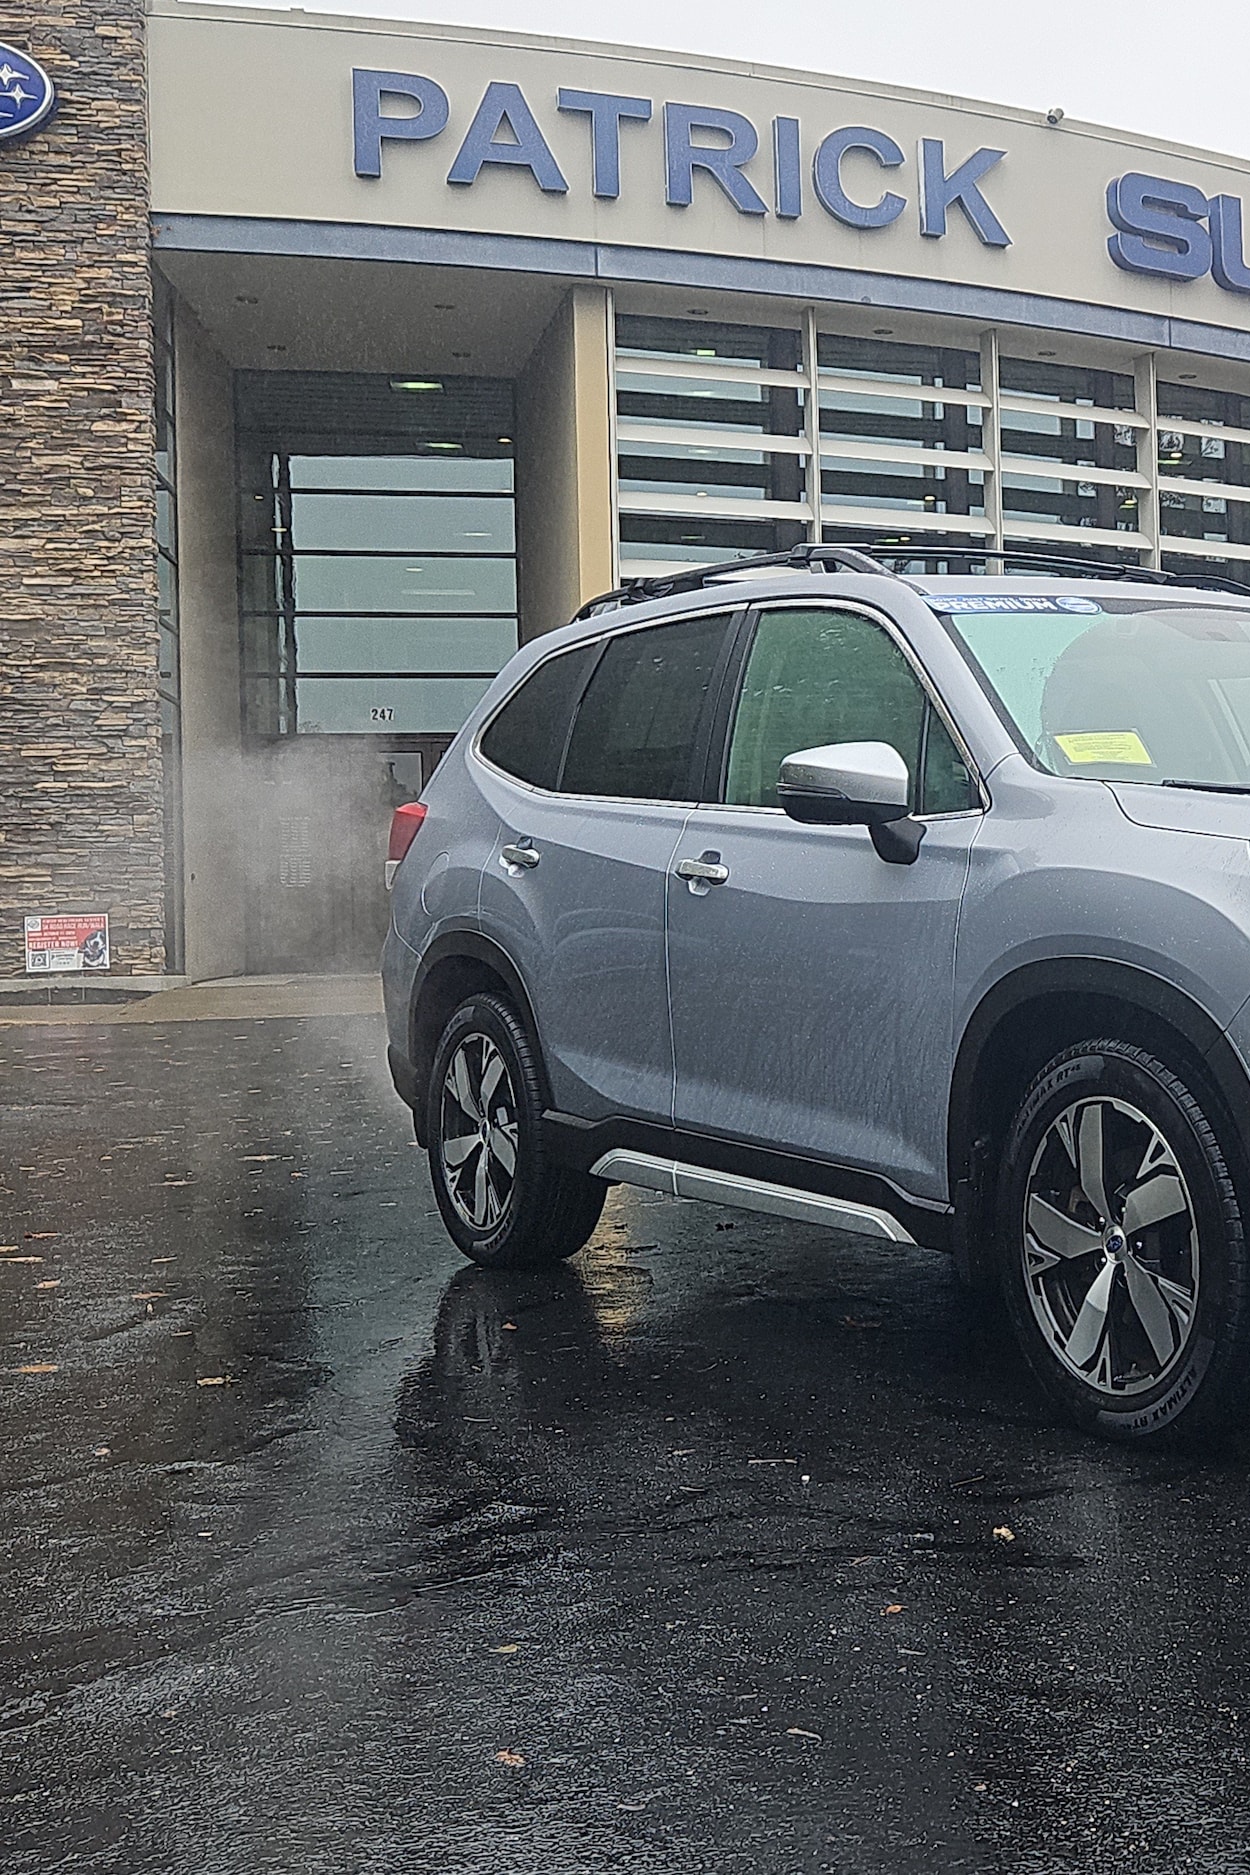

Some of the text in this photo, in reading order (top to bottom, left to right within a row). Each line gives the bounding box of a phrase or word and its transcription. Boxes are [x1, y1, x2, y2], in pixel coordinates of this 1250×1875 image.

[351, 67, 1013, 249] PATRICK
[933, 600, 1058, 611] PREMIUM
[371, 708, 394, 721] 247
[28, 941, 60, 949] REGISTER
